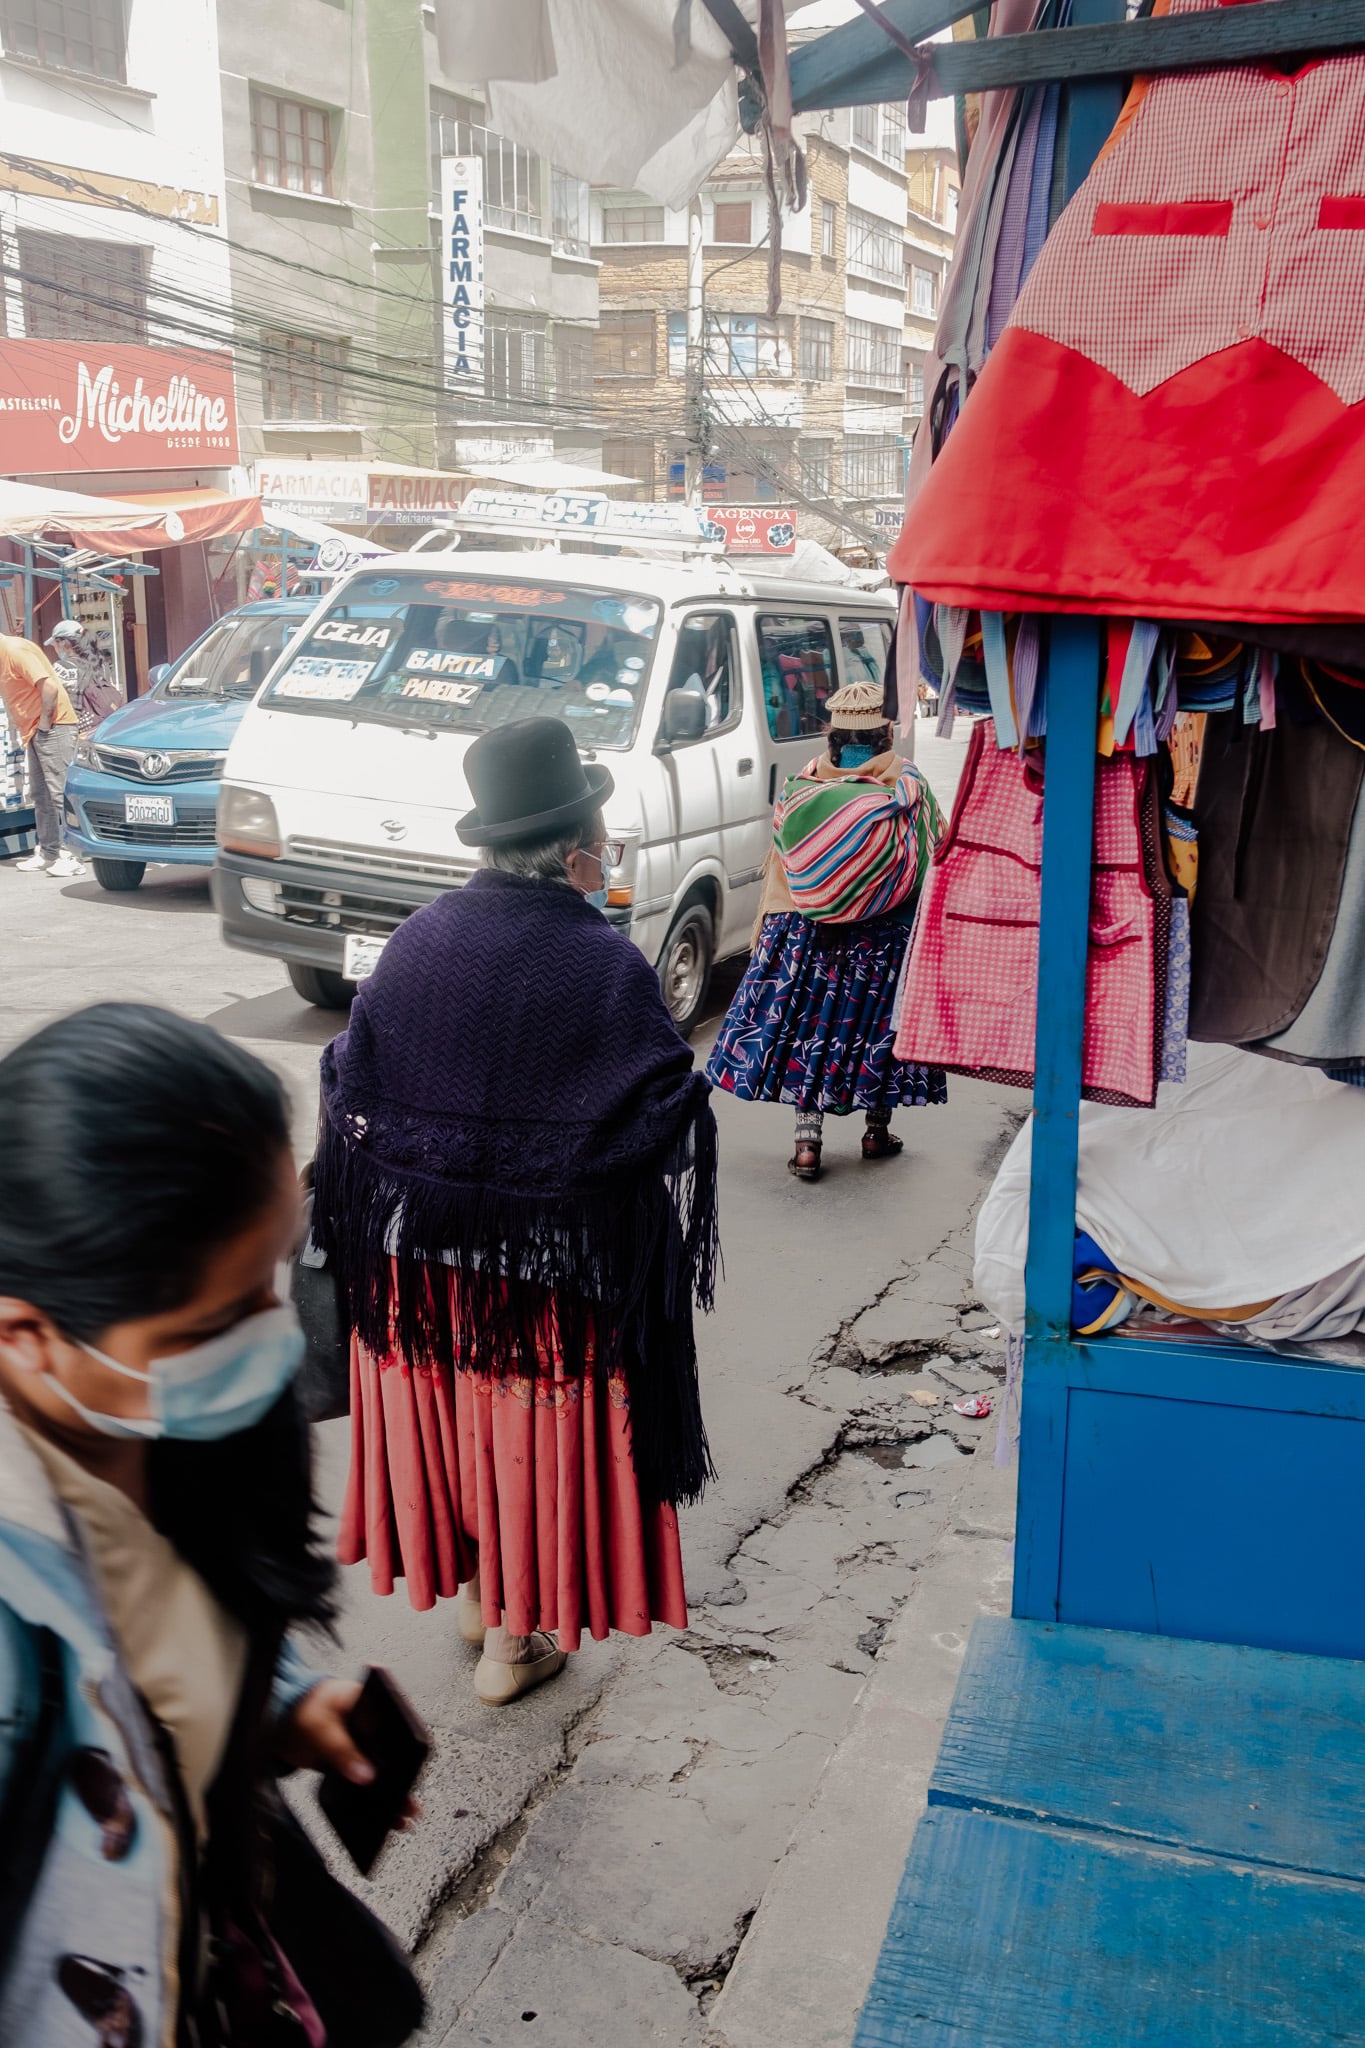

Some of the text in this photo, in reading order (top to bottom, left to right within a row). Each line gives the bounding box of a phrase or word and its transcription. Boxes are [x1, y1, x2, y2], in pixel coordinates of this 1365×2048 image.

[450, 190, 472, 374] FARMACIA
[0, 394, 62, 410] ASTELERÍA
[59, 361, 228, 443] Michelline
[167, 436, 230, 448] DESDE 1988
[259, 473, 362, 497] FARMACIA
[543, 496, 609, 526] 951
[713, 509, 791, 520] AGENCIA
[313, 621, 391, 648] CEJA
[406, 650, 495, 677] GARITA
